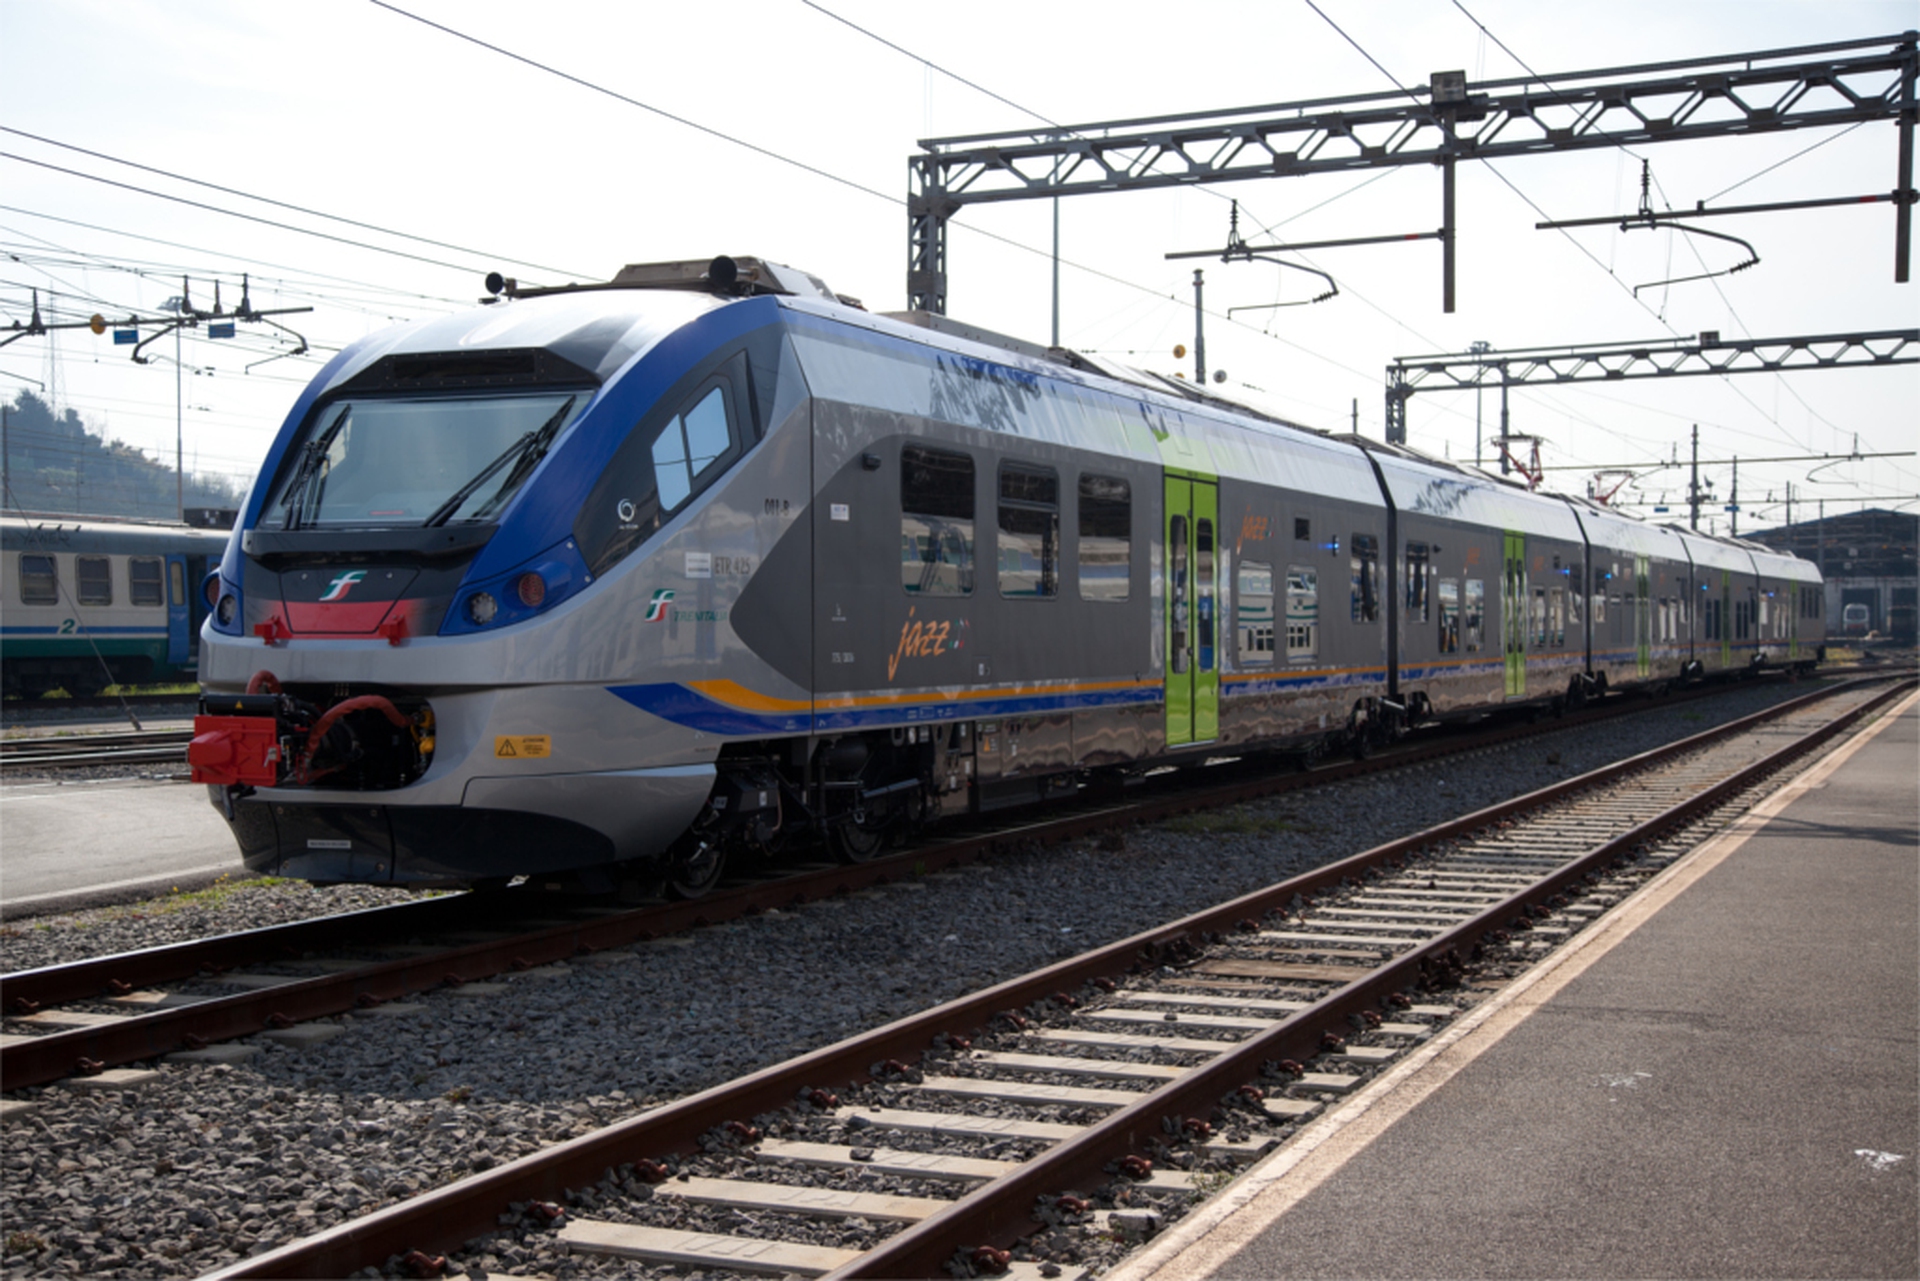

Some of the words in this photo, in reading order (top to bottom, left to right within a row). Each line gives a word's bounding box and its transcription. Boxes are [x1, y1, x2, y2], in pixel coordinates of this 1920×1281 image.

[736, 557, 751, 576] 425
[60, 618, 75, 634] 2
[887, 605, 951, 682] jazz
